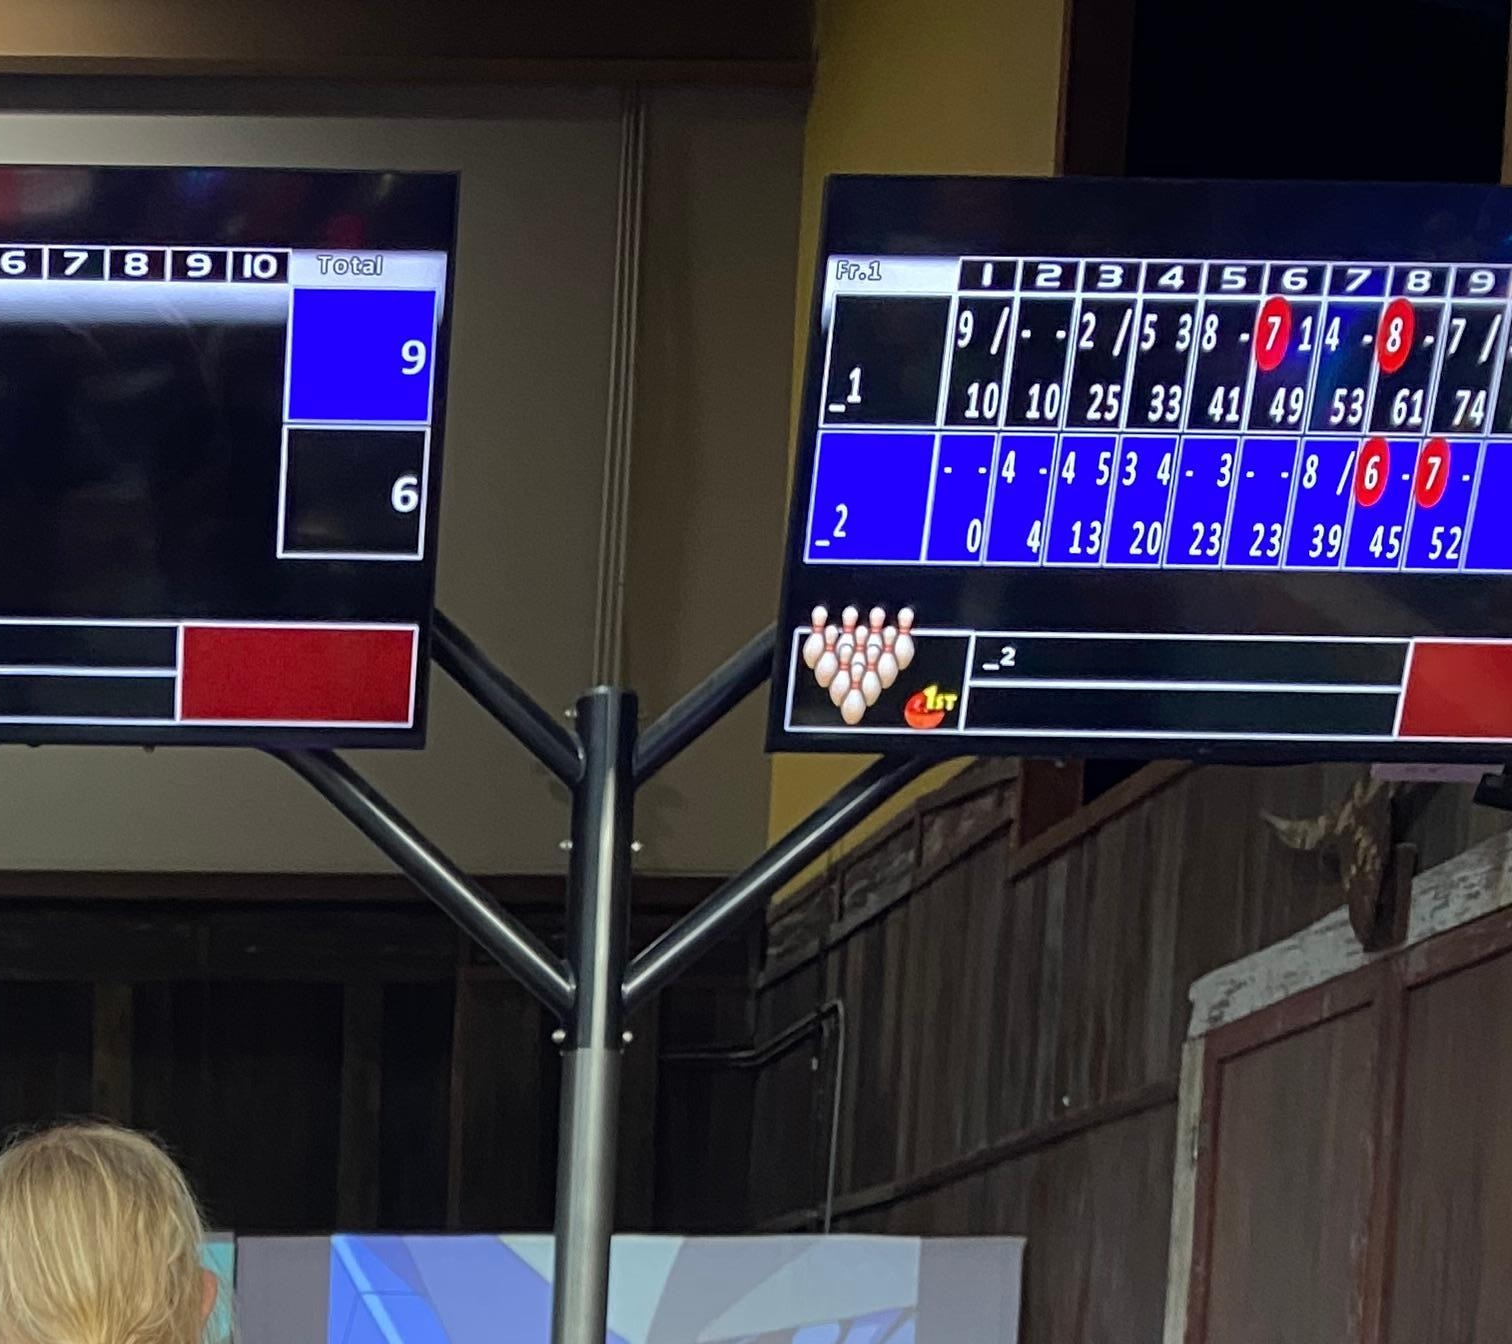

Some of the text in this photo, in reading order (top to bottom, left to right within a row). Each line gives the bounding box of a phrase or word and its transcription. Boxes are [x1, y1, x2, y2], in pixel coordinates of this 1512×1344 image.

[0, 250, 26, 274] 6
[63, 251, 88, 275] 7
[123, 252, 149, 276] 8
[186, 253, 213, 277] 9
[242, 254, 277, 278] 10
[318, 255, 383, 275] Total
[836, 260, 1496, 293] Fr.1 1 2 3 4 5 6 7 8 9
[957, 310, 974, 348] 9
[1079, 313, 1096, 349] 2
[1140, 314, 1158, 349] 5
[1175, 314, 1192, 351] 3
[1201, 314, 1218, 351] 8
[1265, 316, 1282, 350] 7
[1297, 316, 1313, 351] 1
[1325, 316, 1340, 351] 4
[1387, 317, 1403, 352] 8
[1449, 318, 1466, 355] 7
[400, 339, 426, 375] 9
[964, 382, 999, 419] 10
[1026, 383, 1060, 420] 10
[1087, 384, 1121, 421] 25
[1147, 384, 1182, 423] 33
[1208, 386, 1240, 423] 41
[1269, 387, 1304, 424] 49
[1330, 388, 1364, 425] 53
[1392, 389, 1424, 425] 61
[1451, 390, 1487, 426] 74
[1002, 450, 1016, 483] 4
[1061, 451, 1076, 484] 4
[1096, 452, 1111, 485] 5
[1122, 452, 1137, 485] 3
[1156, 453, 1171, 485] 4
[1216, 453, 1232, 487] 3
[1302, 455, 1318, 488] 8
[1364, 456, 1380, 490] 6
[1425, 456, 1441, 490] 7
[391, 475, 419, 513] 6
[966, 519, 982, 553] 0
[1026, 520, 1042, 553] 4
[1069, 521, 1102, 554] 13
[1129, 521, 1162, 555] 20
[1189, 522, 1222, 556] 23
[1249, 523, 1282, 557] 23
[1309, 524, 1342, 558] 39
[1369, 525, 1402, 558] 45
[1428, 526, 1462, 560] 52
